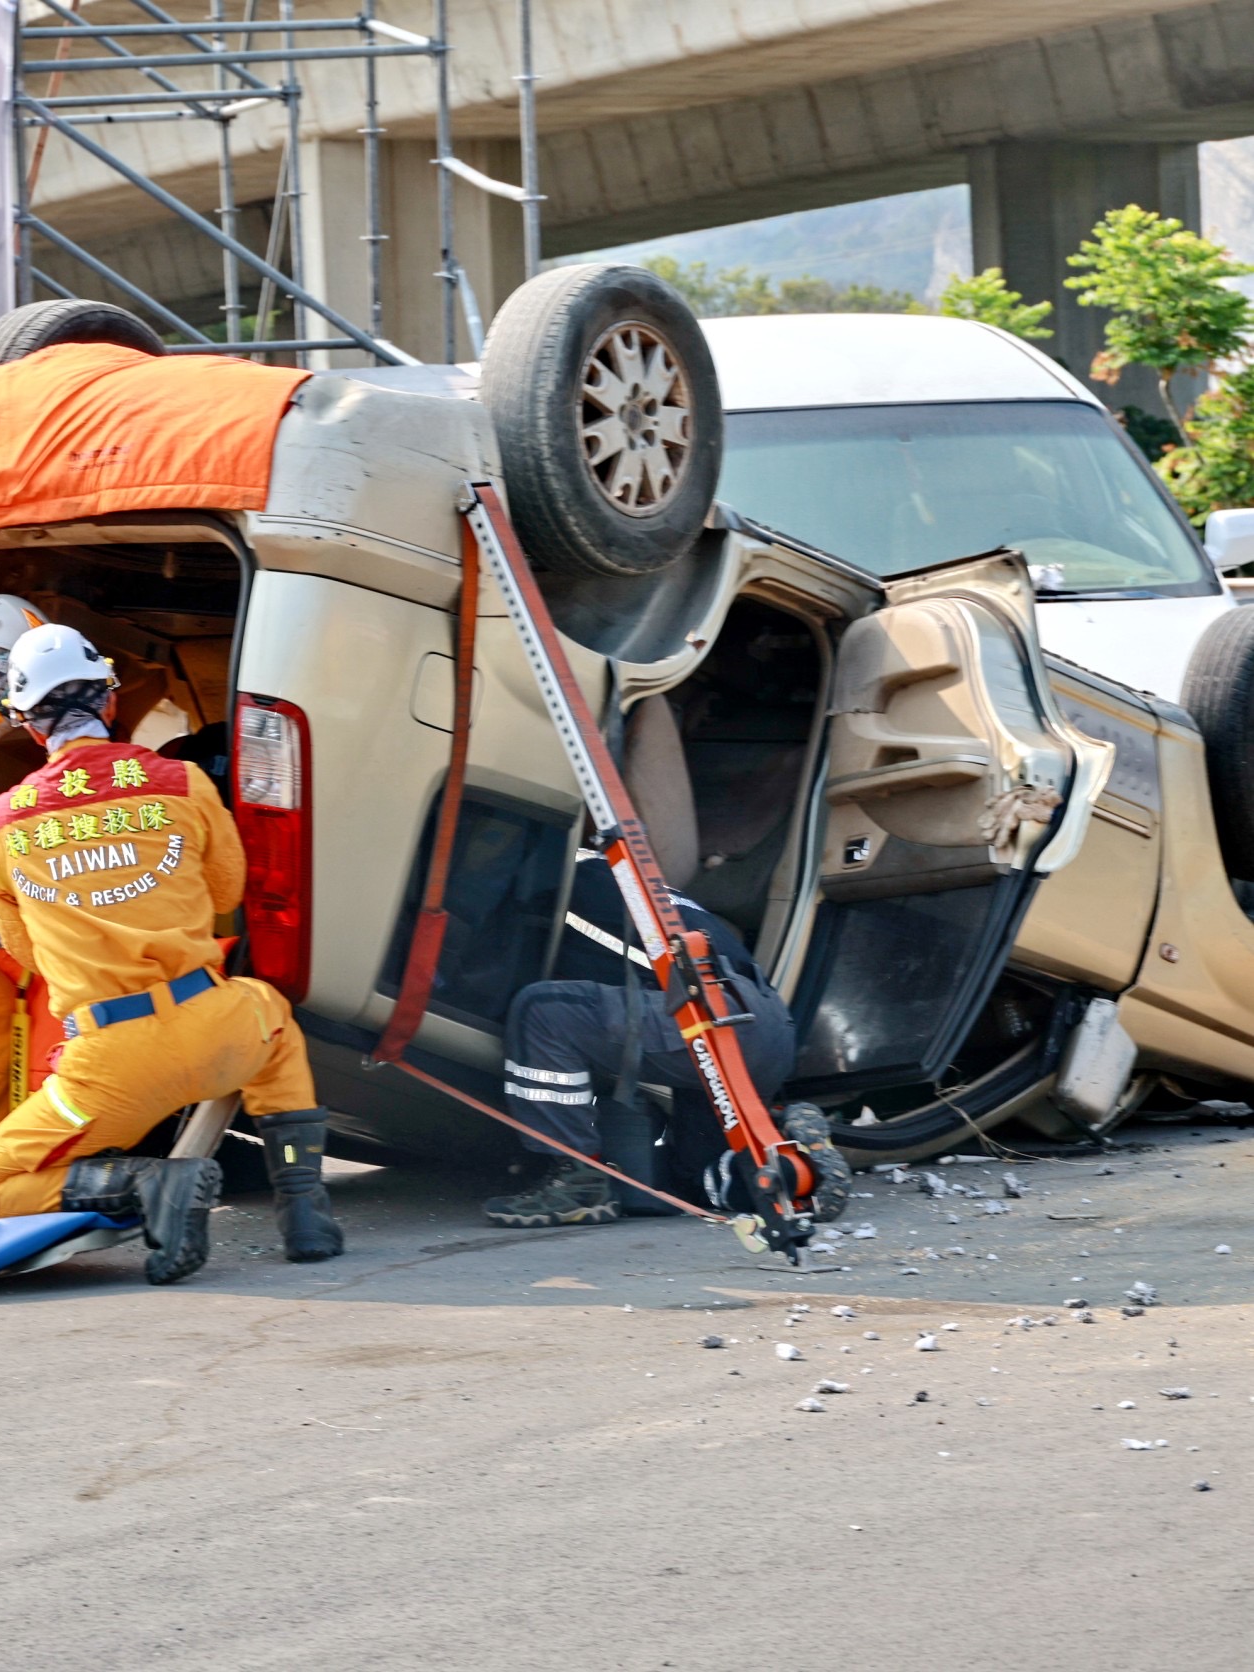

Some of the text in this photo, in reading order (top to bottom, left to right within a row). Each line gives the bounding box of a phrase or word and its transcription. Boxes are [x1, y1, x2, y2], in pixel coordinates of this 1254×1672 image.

[9, 758, 150, 811] 南投縣
[5, 801, 175, 859] 特種搜救隊
[12, 834, 184, 906] SEARCH & RESCUE TEAM
[46, 842, 138, 881] TAIWAN
[691, 1036, 741, 1132] holmatro
